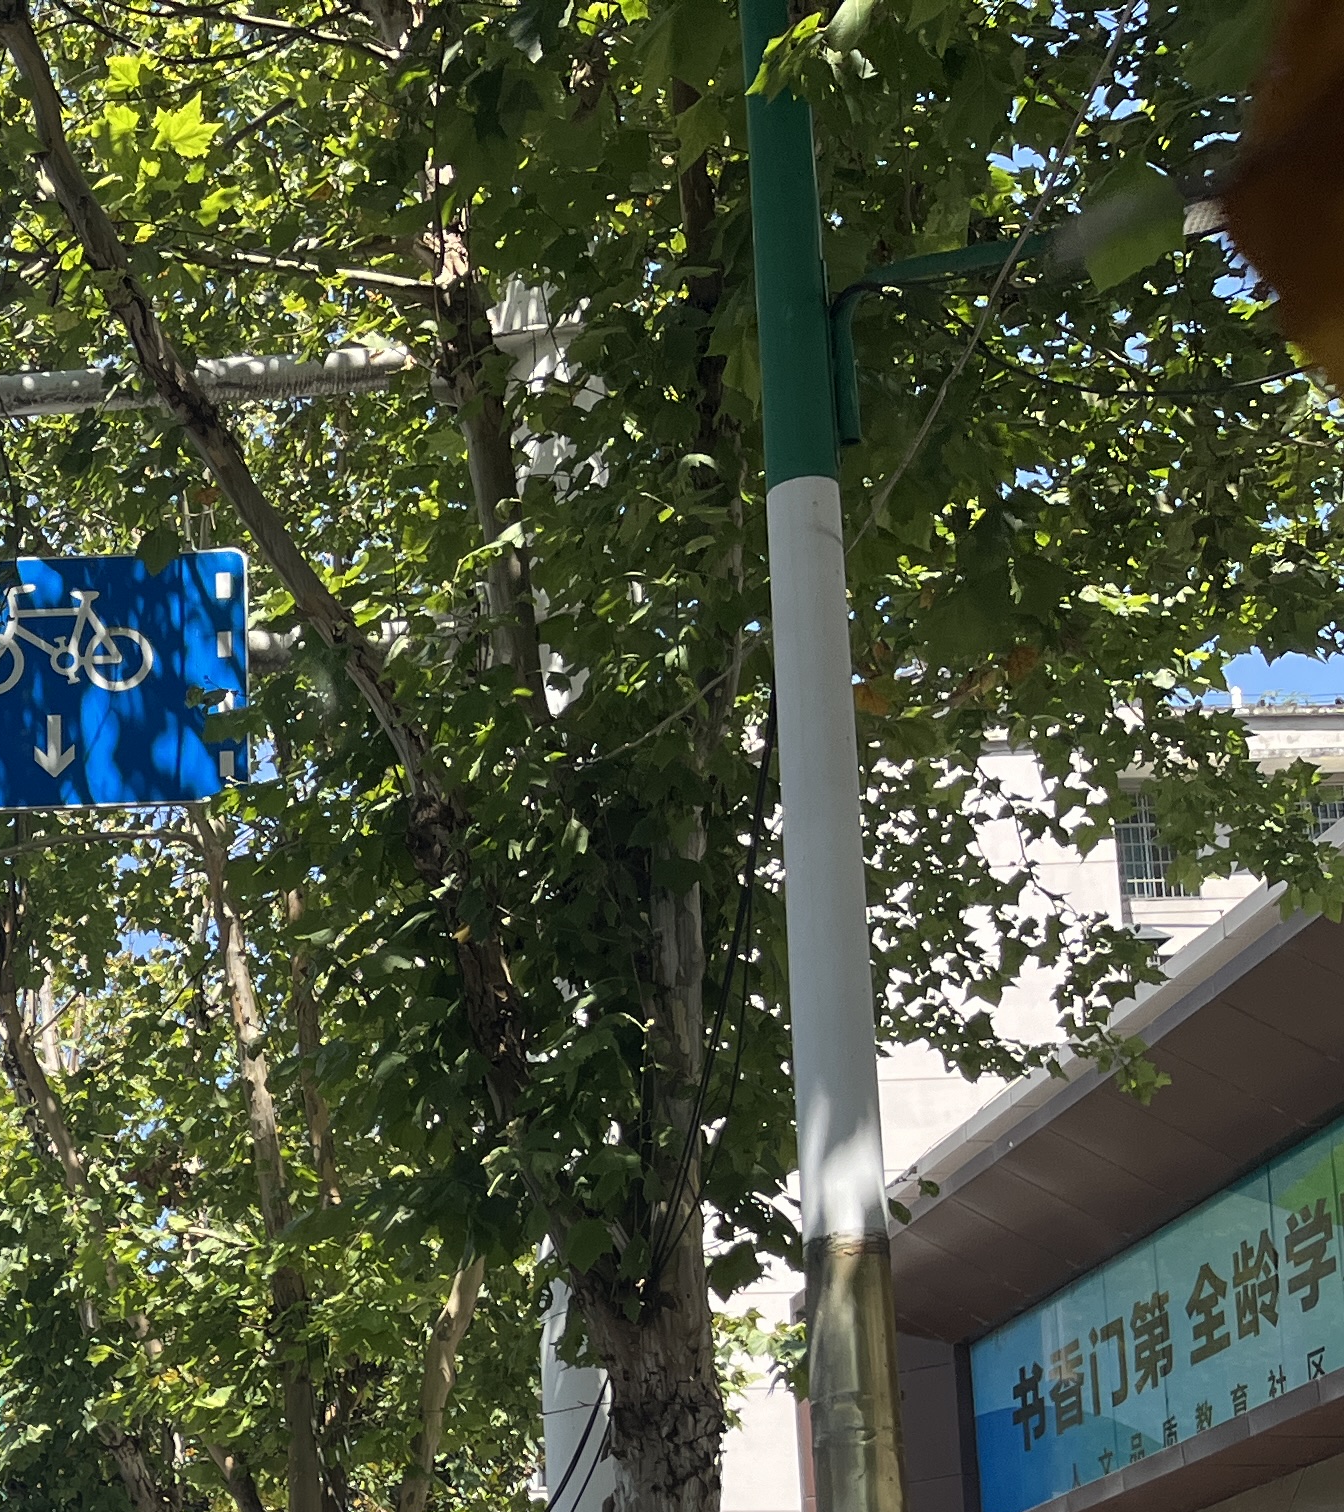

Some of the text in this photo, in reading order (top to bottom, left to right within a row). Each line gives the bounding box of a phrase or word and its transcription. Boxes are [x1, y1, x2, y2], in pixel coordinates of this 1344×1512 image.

[1012, 1193, 1344, 1453] 书香门第 全龄学
[1070, 1346, 1326, 1490] 人文品质教育社区
